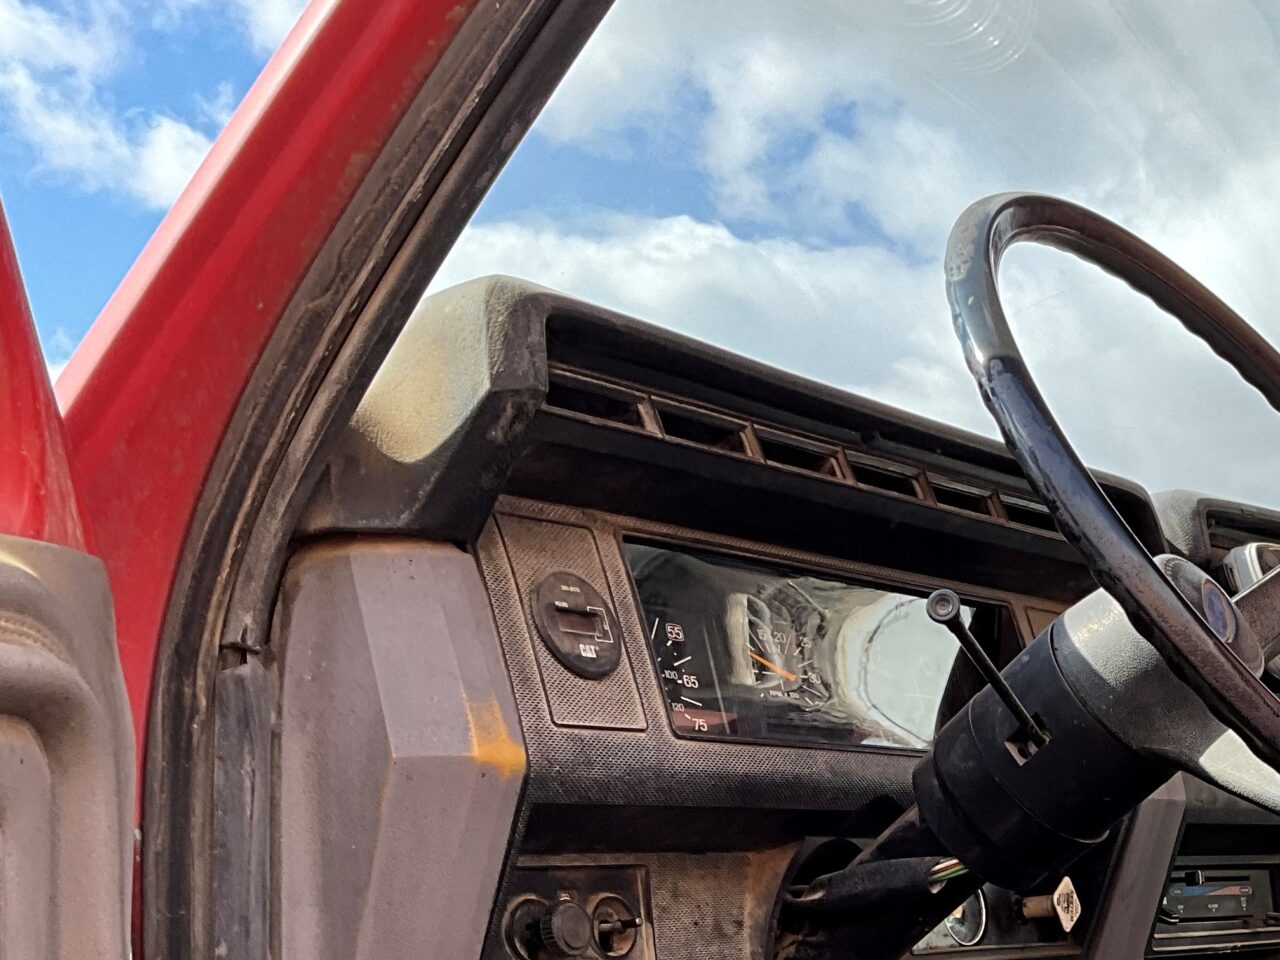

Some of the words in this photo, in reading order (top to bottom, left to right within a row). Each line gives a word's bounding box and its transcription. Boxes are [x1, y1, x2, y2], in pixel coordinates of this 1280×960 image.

[667, 626, 683, 640] 55
[757, 630, 766, 640] 15
[774, 632, 786, 643] 20
[800, 636, 812, 648] 25
[579, 644, 597, 658] CAT
[665, 670, 678, 680] 100
[808, 673, 821, 684] 30
[682, 674, 699, 688] 65
[672, 703, 685, 712] 120
[692, 719, 708, 731] 75
